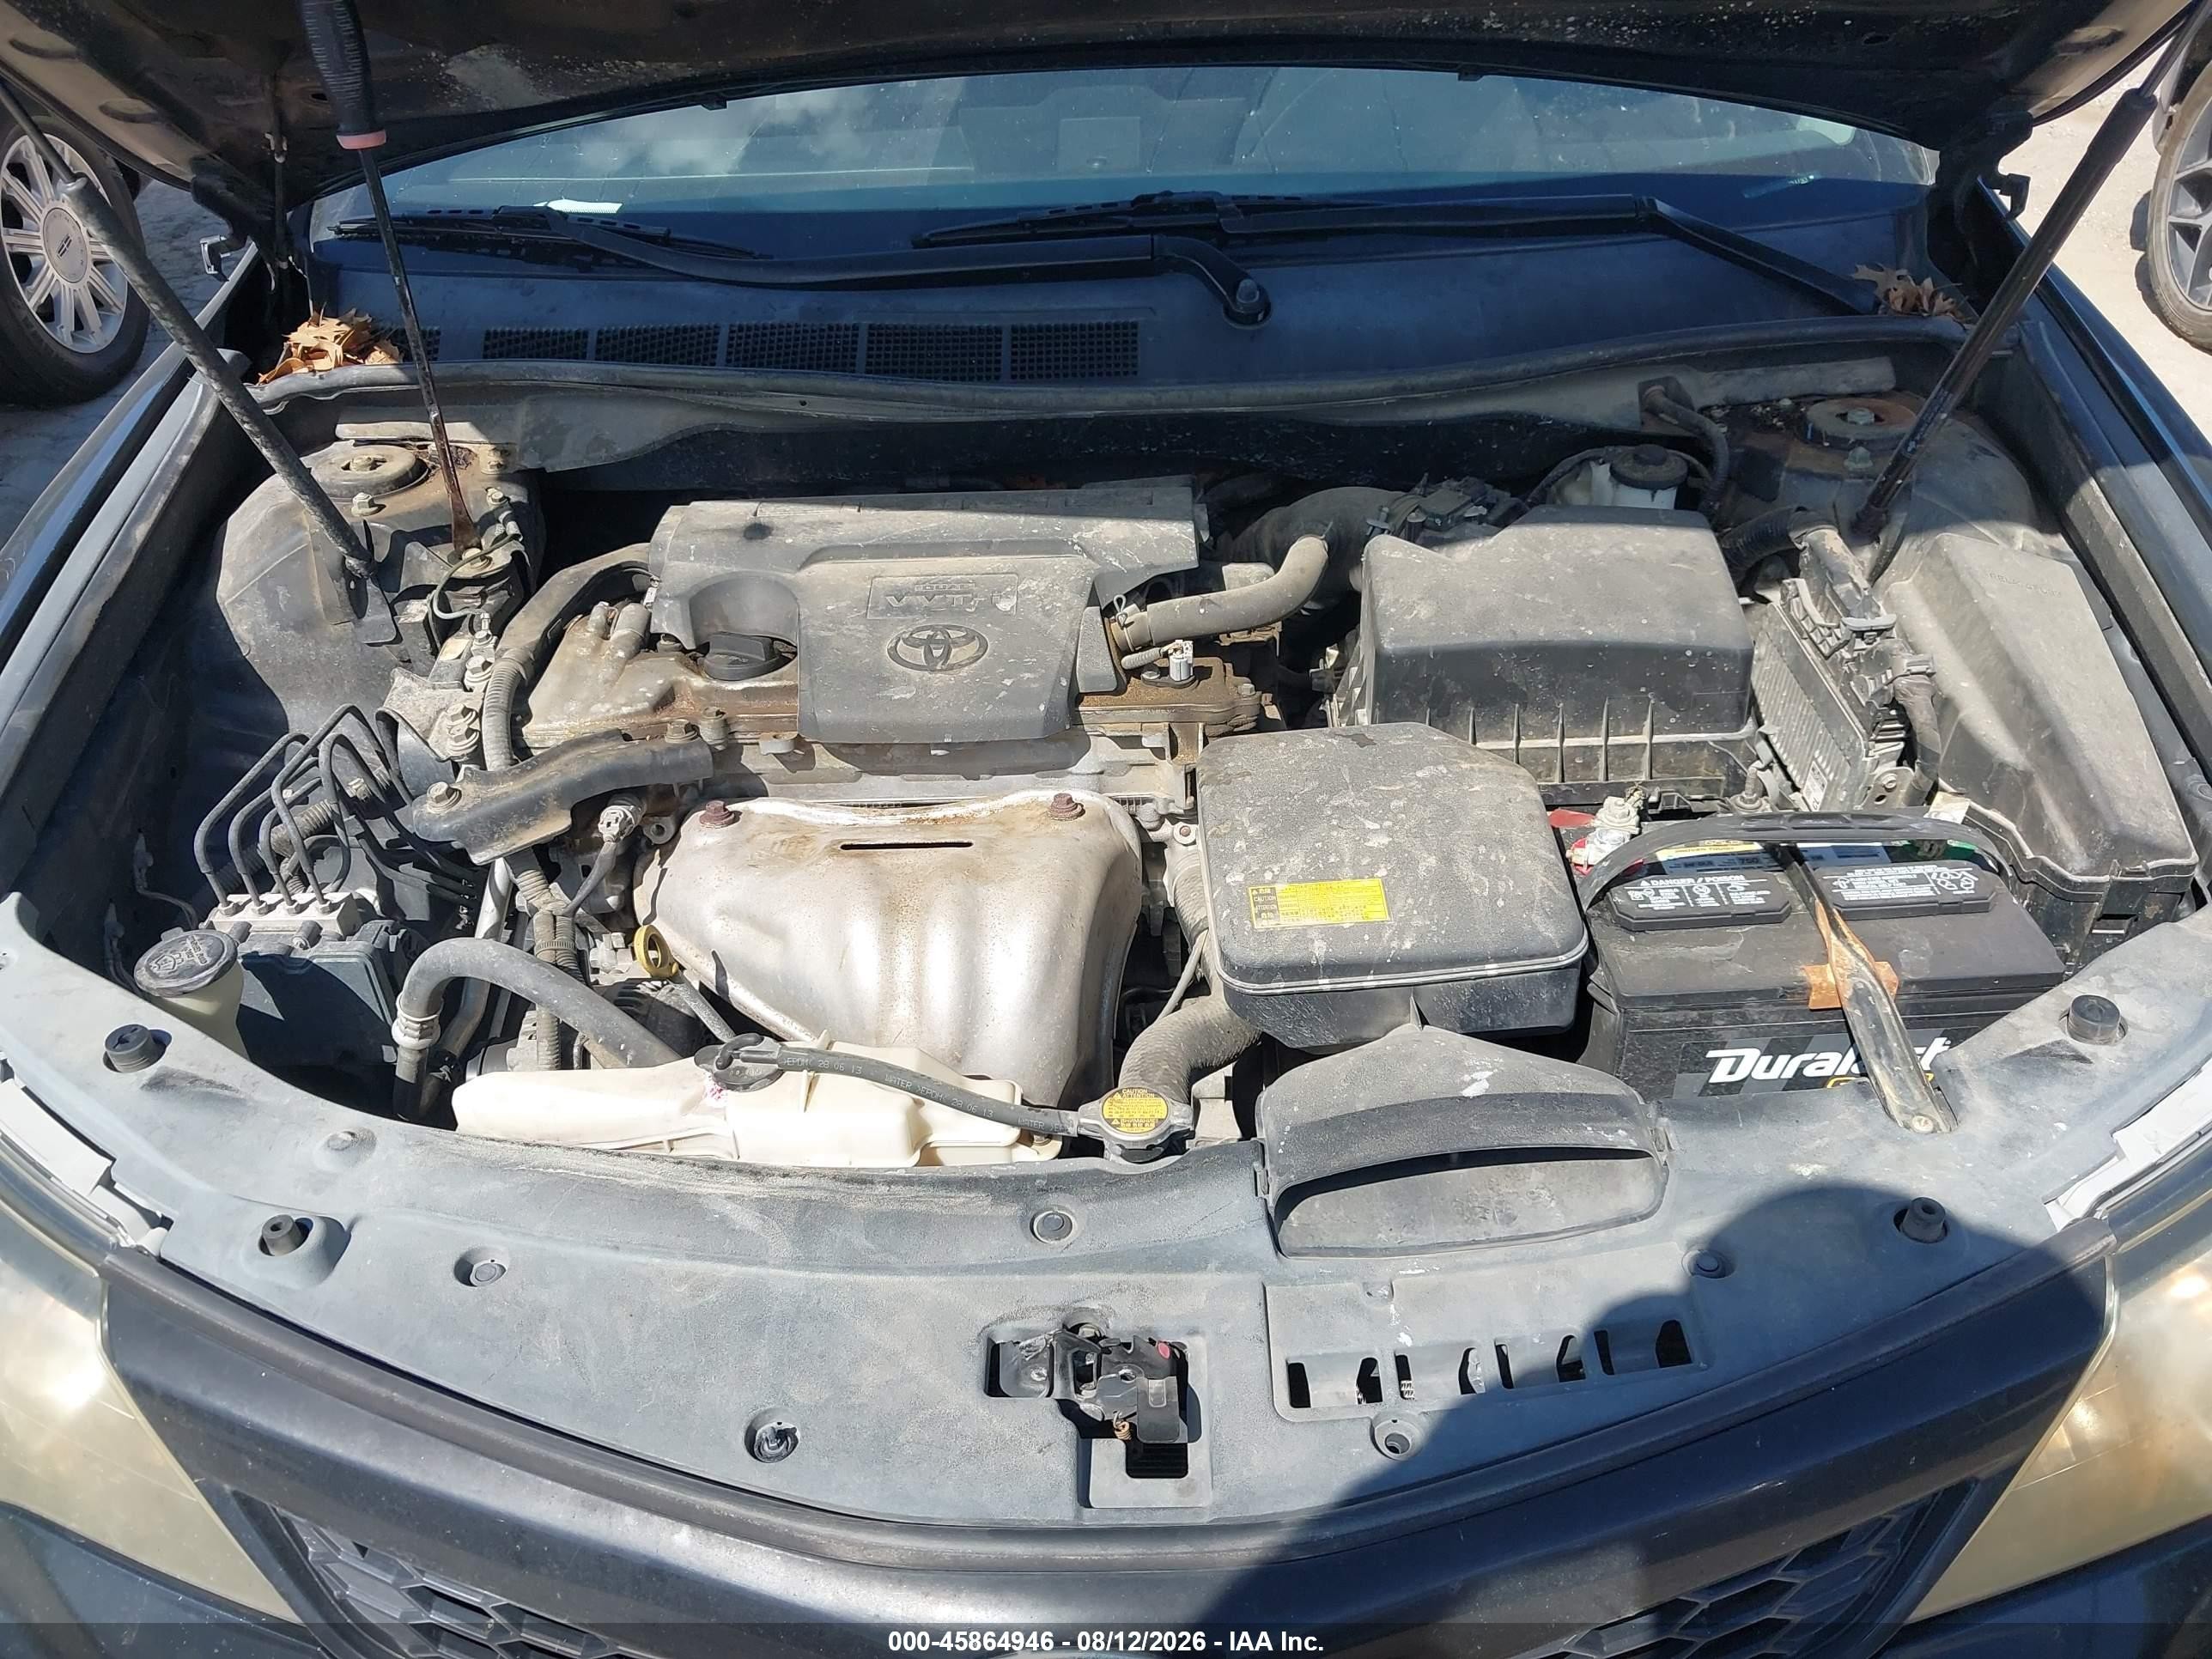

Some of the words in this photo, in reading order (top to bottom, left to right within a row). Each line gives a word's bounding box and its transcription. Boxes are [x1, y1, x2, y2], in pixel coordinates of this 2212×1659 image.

[1650, 878, 1695, 887] DANGER
[1705, 874, 1746, 884] POISON
[817, 1060, 830, 1069] 28
[851, 1064, 863, 1074] 13
[1705, 1036, 1948, 1084] Duralt
[884, 1074, 913, 1092] WATER
[982, 1107, 994, 1118] 13
[1018, 1117, 1046, 1131] WATER
